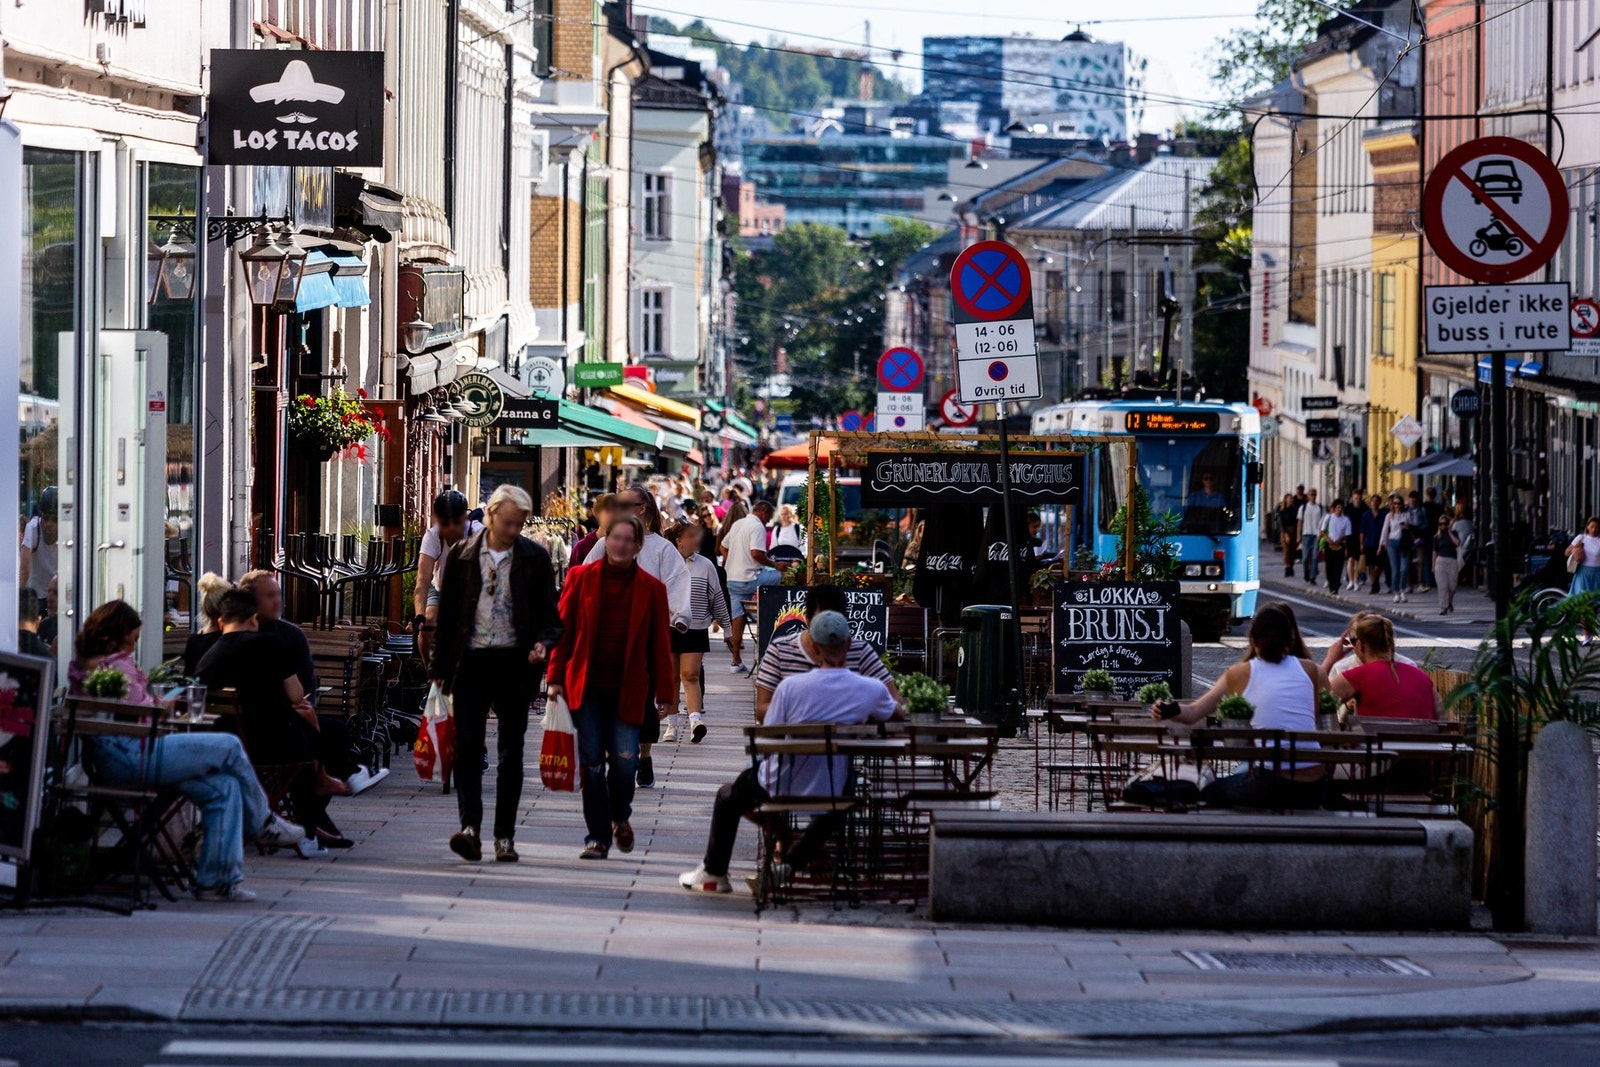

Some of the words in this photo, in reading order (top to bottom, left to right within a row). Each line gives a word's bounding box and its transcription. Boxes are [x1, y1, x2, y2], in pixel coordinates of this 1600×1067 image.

[233, 129, 278, 150] LOS
[283, 129, 359, 151] TACOS
[1432, 296, 1510, 319] Gjelder
[1519, 294, 1562, 312] ikke
[1438, 323, 1489, 341] buss
[1499, 321, 1504, 340] i
[1514, 322, 1558, 340] rute
[975, 340, 1018, 354] (12-06)
[974, 386, 1005, 399] Øvrig
[1010, 383, 1026, 395] tid
[1453, 396, 1479, 411] CHAIR
[542, 410, 552, 419] G
[1089, 587, 1148, 604] LØKKA
[1067, 608, 1166, 641] BRUNSJ
[1101, 659, 1120, 669] 12-16
[539, 754, 568, 768] EXTRA
